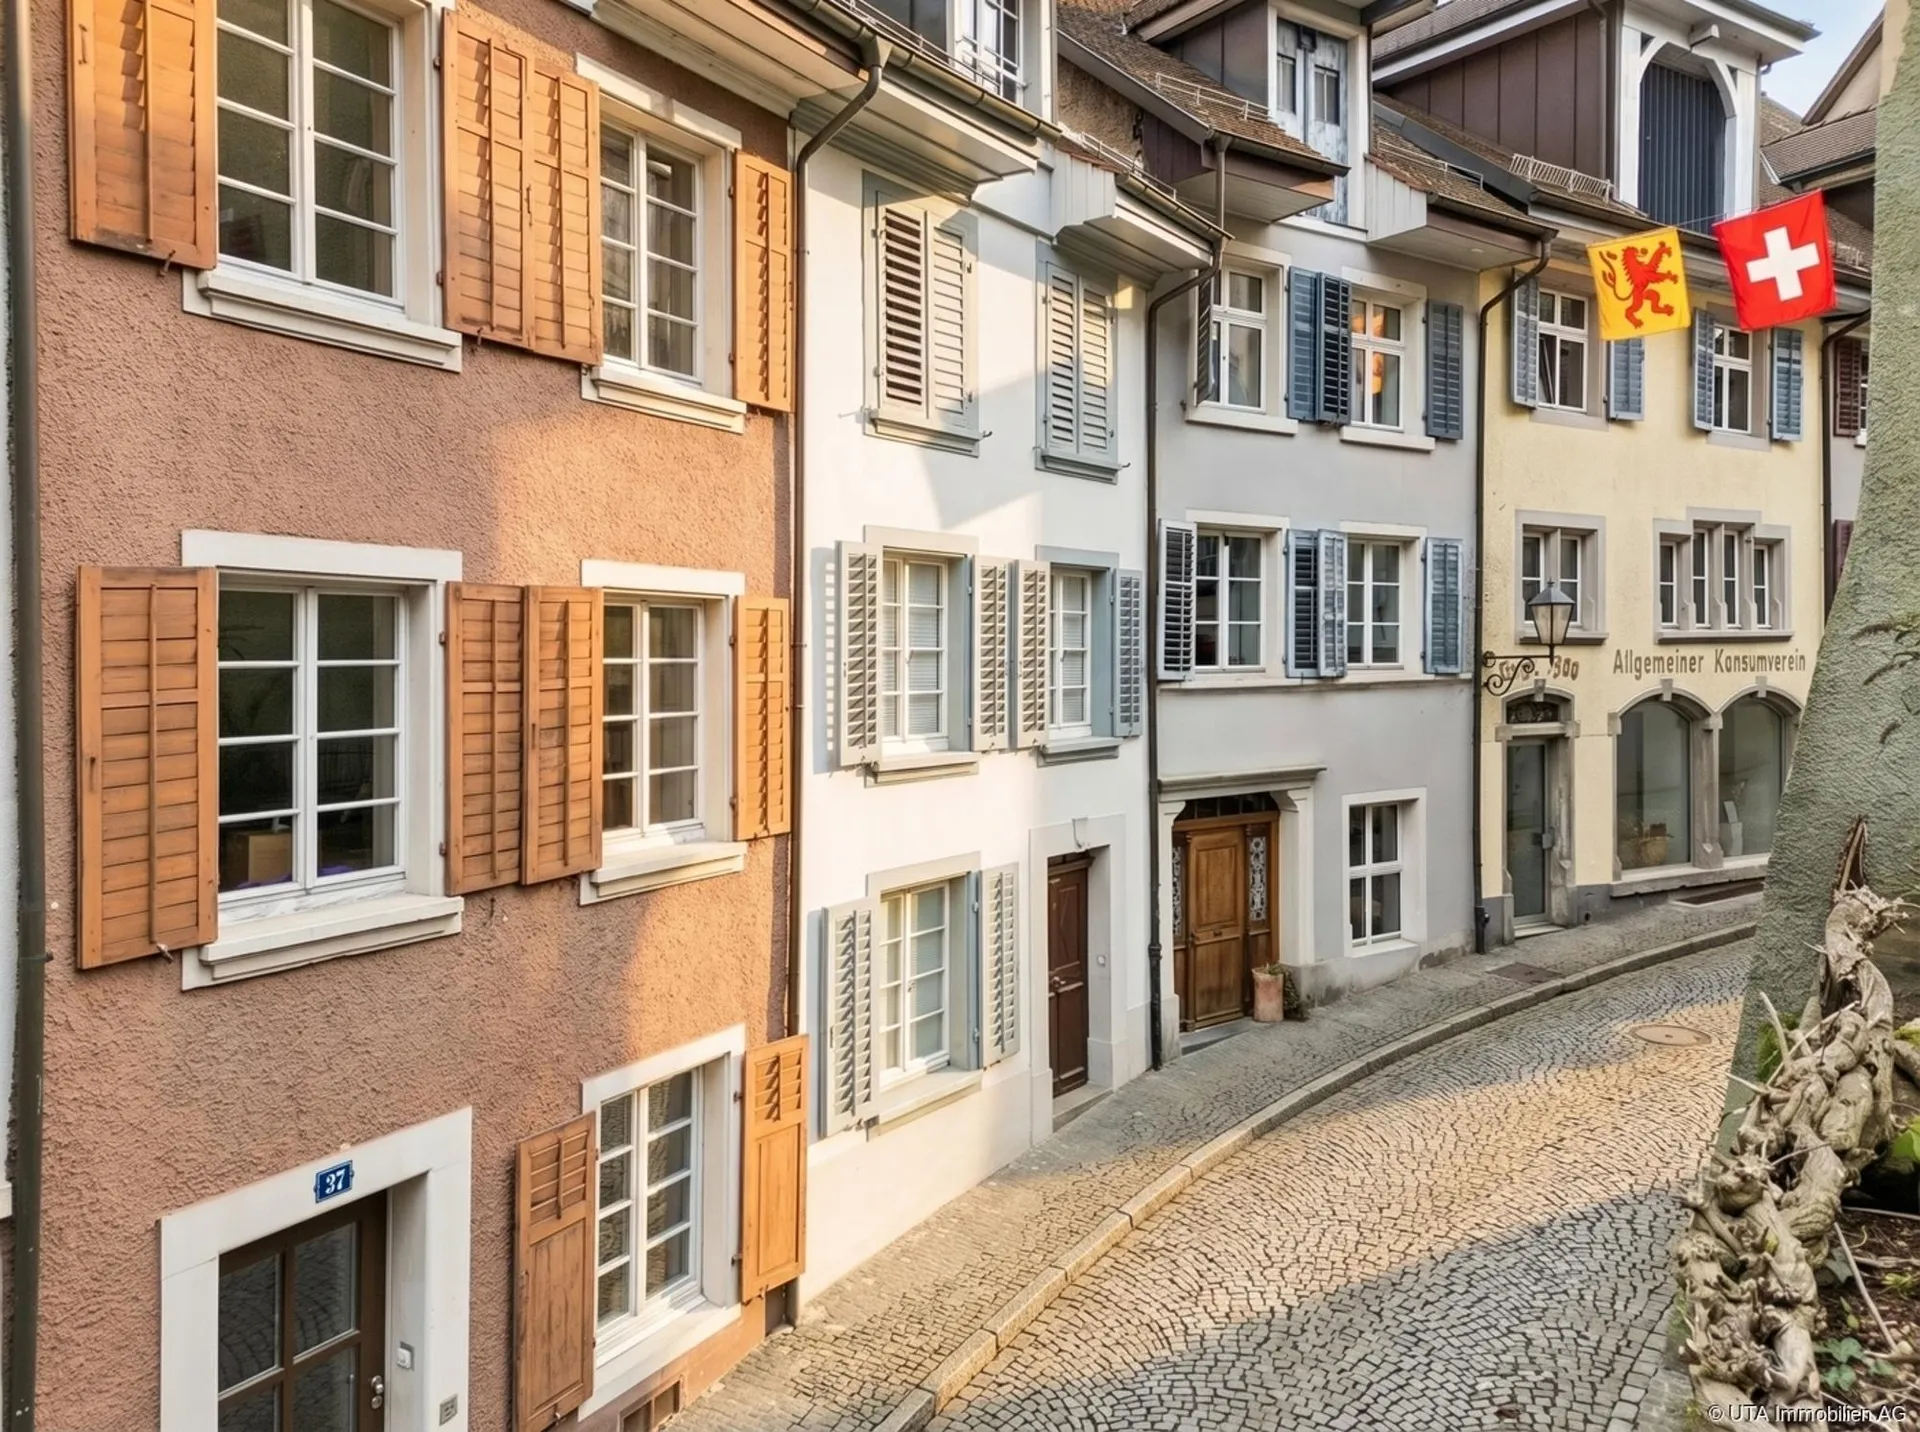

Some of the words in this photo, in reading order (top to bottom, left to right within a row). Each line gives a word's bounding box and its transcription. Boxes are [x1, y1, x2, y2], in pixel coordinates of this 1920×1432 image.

[1613, 648, 1704, 681] Allgemeiner
[1714, 648, 1806, 673] Konsumverein
[325, 1168, 346, 1194] 37
